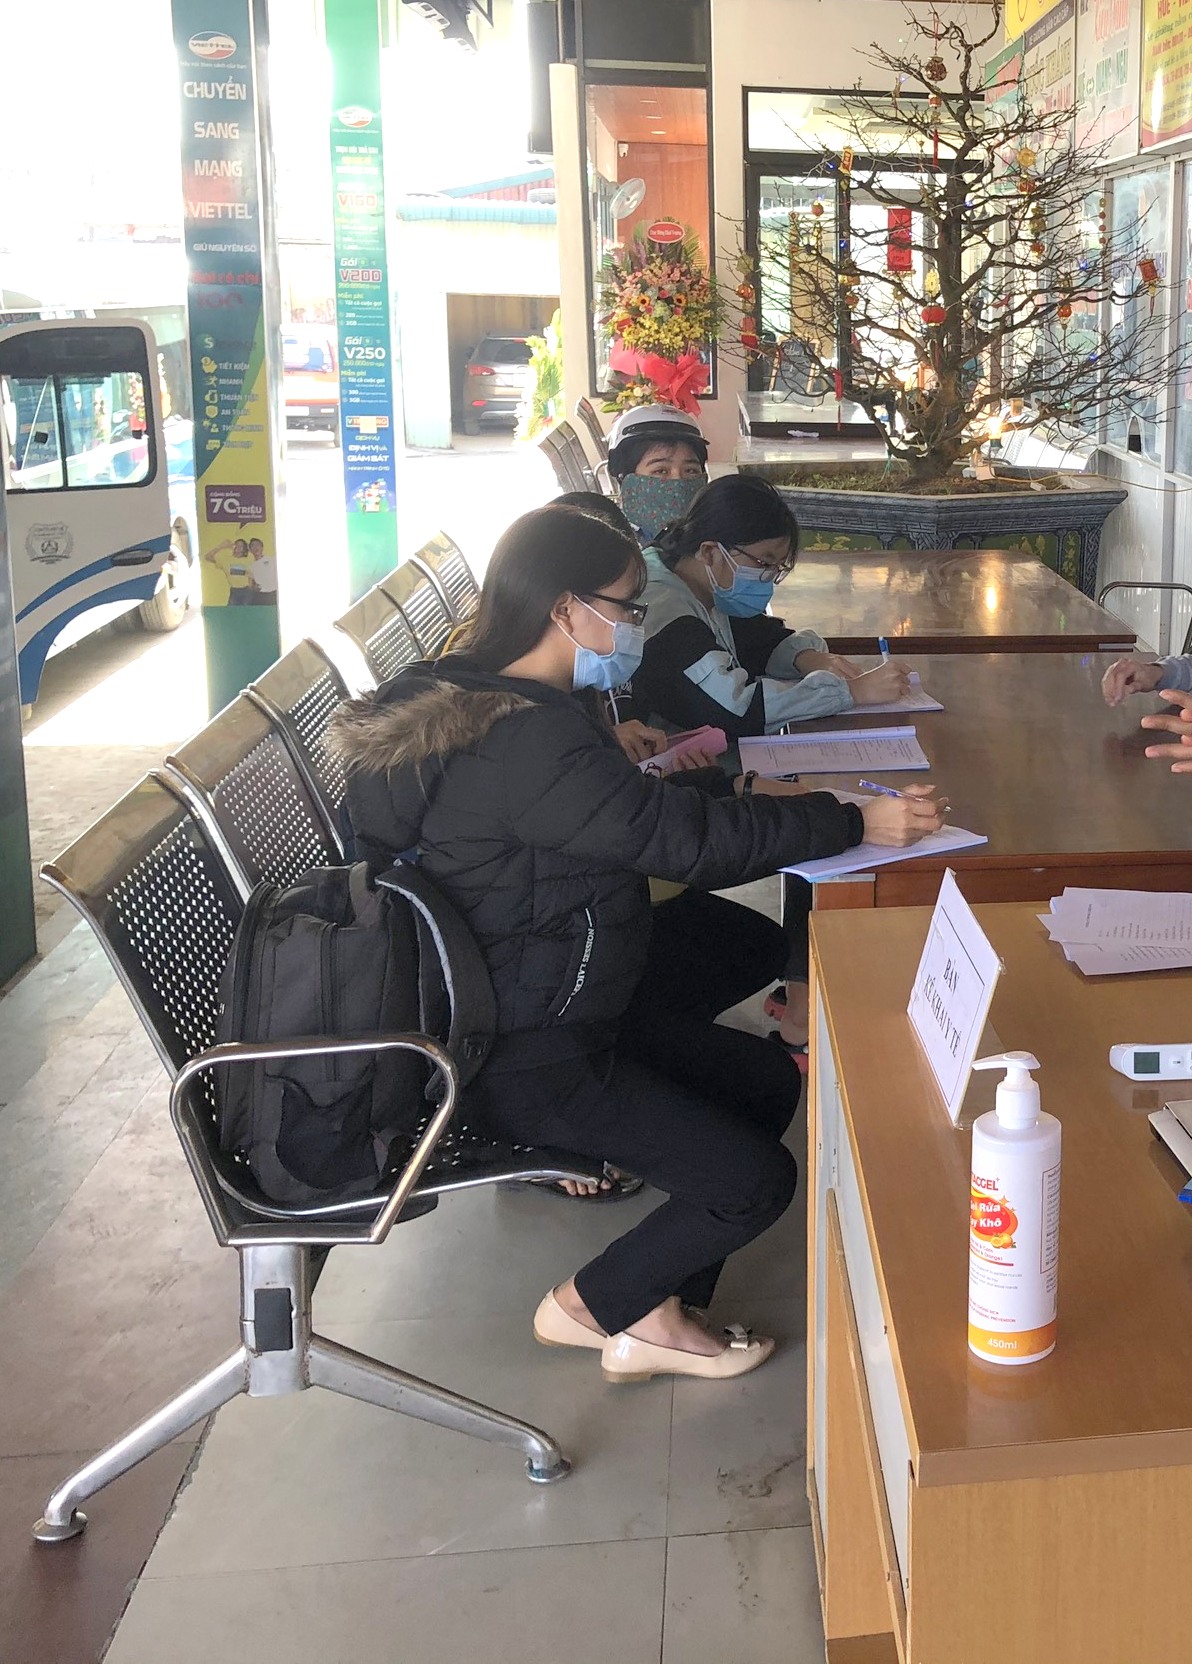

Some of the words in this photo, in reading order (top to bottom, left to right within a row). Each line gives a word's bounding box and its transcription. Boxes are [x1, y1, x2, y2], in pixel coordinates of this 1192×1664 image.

[183, 76, 246, 100] CHUYỂN
[194, 121, 240, 139] SANG
[194, 160, 243, 179] MẠNG
[188, 201, 252, 219] VIETTEL
[339, 268, 382, 282] V200
[343, 347, 386, 360] V250
[582, 928, 595, 962] SESSION
[979, 1202, 1000, 1212] Rửa
[980, 1217, 1002, 1227] Khô
[987, 1337, 1018, 1350] 450ml
